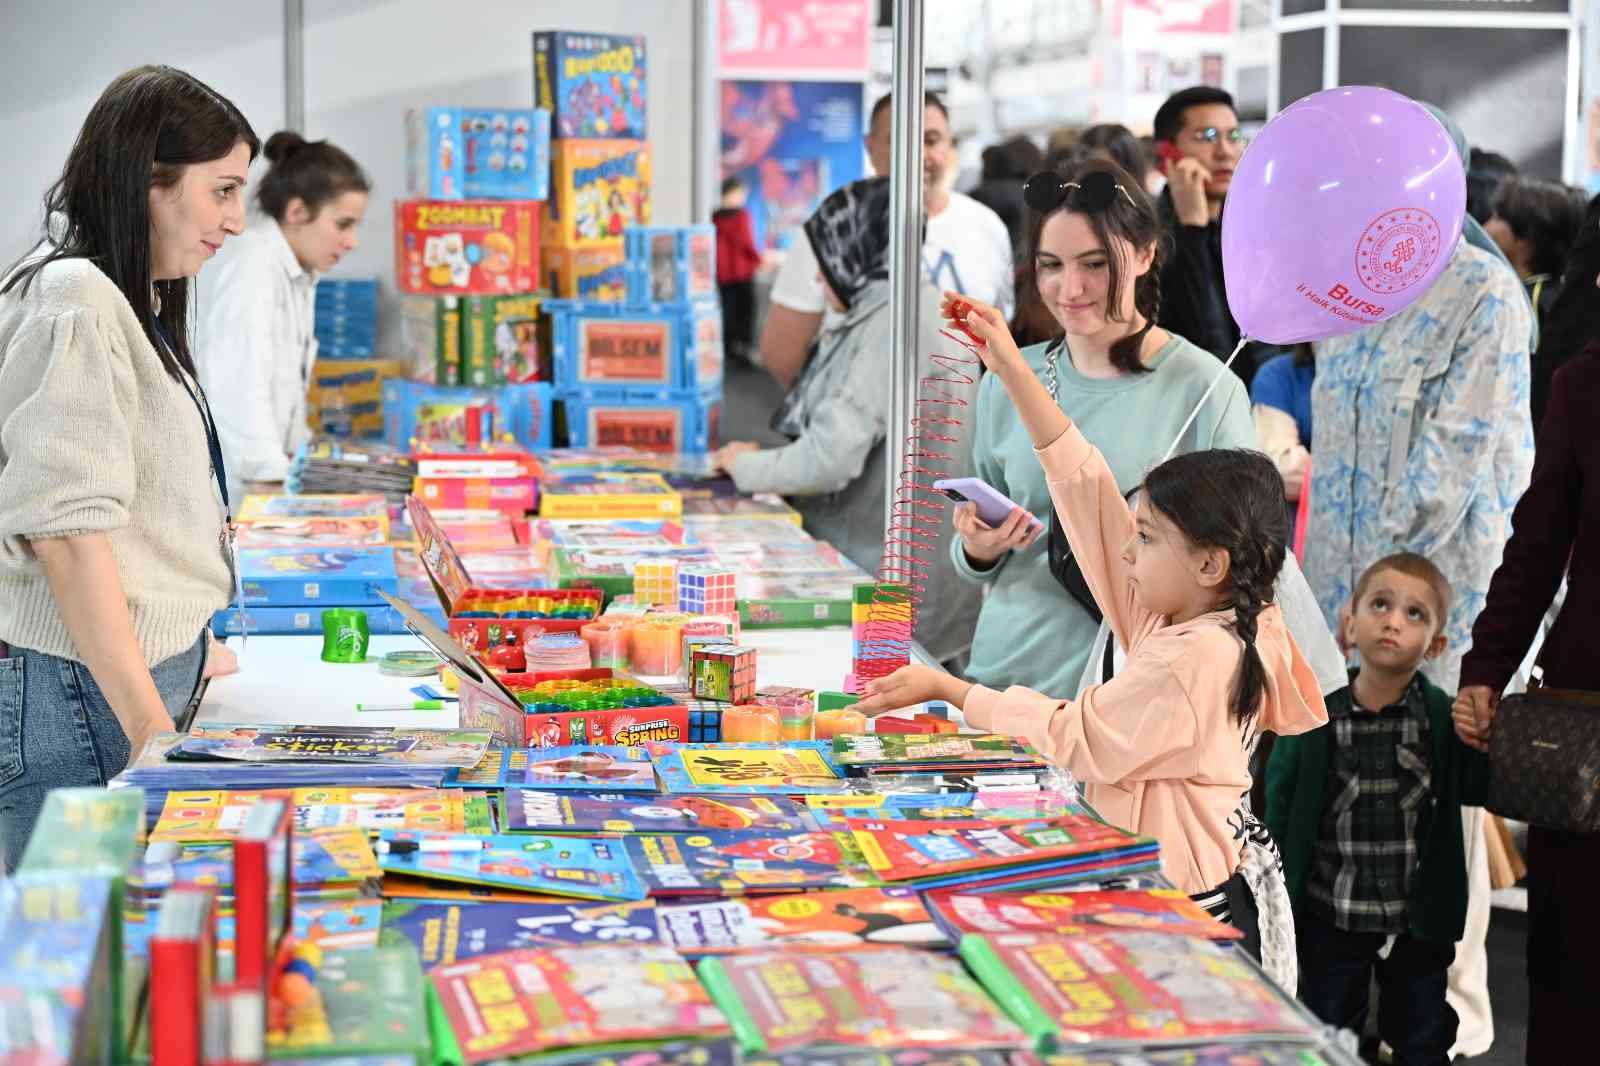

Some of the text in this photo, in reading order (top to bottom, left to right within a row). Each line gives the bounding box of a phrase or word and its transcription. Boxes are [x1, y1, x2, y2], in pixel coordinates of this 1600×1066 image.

[1306, 290, 1329, 309] Halk
[1329, 284, 1385, 316] Bursa
[629, 720, 669, 732] SURPRISE
[616, 727, 679, 746] SPRING
